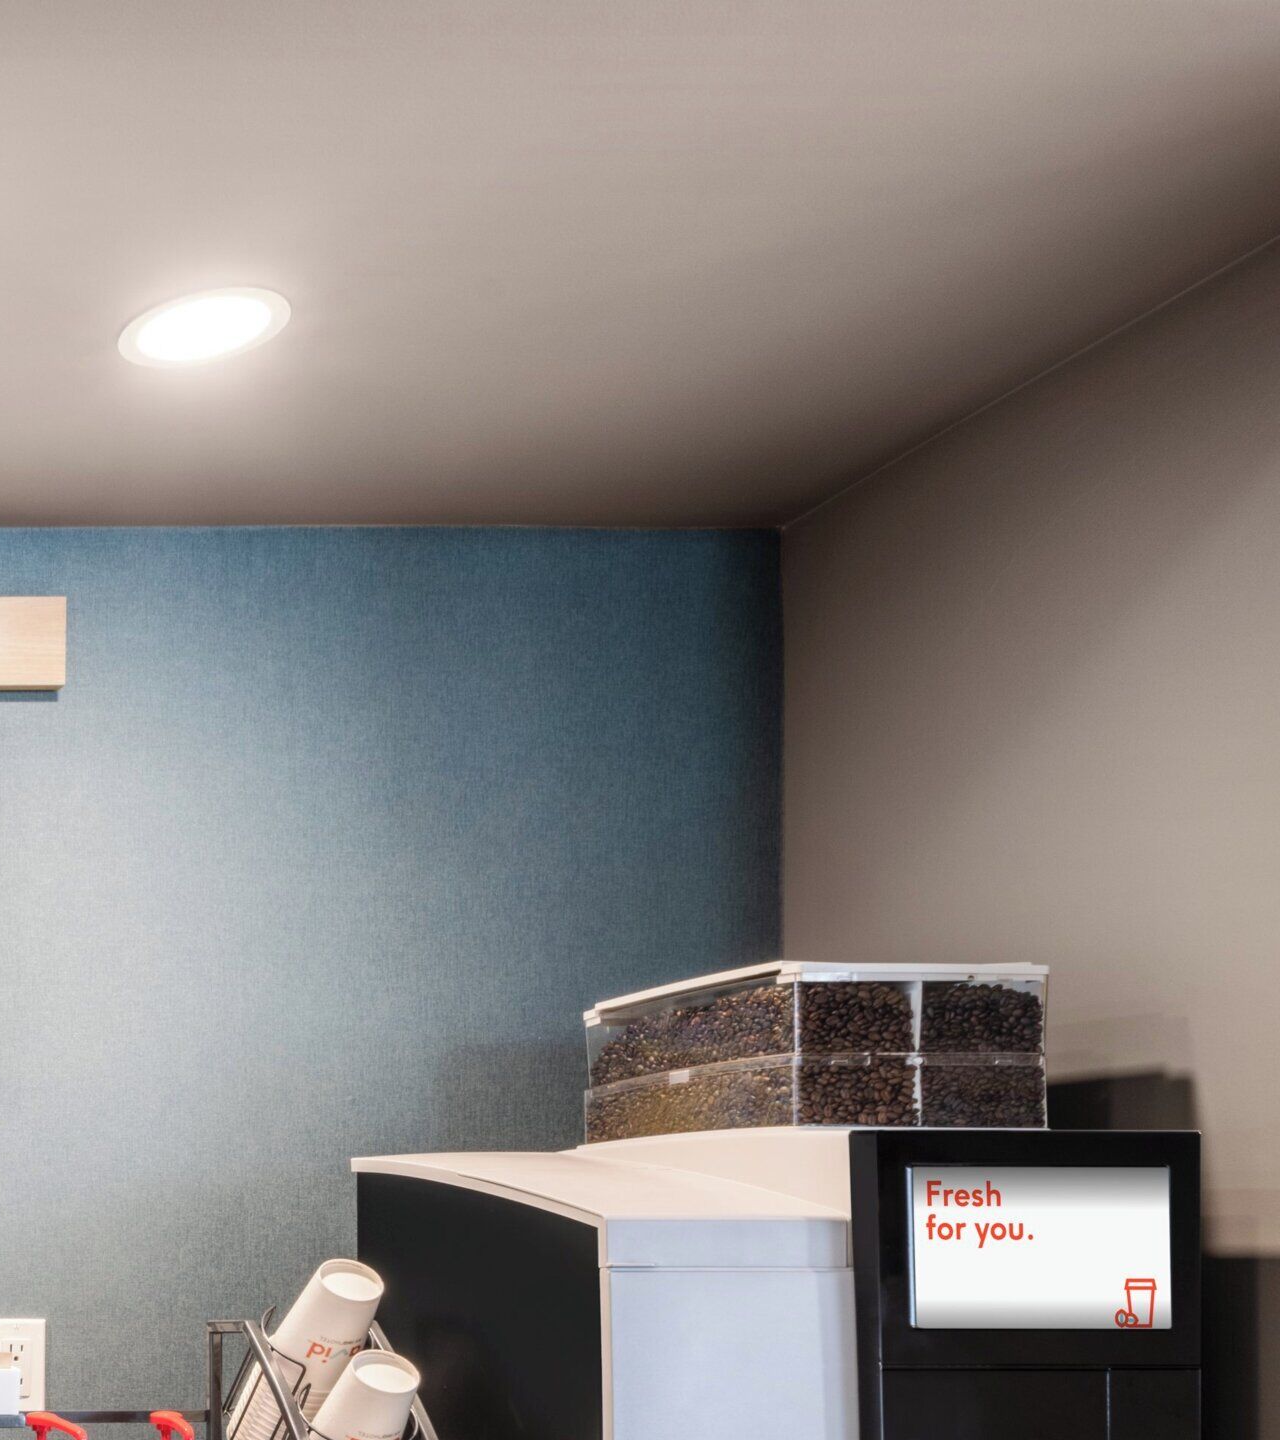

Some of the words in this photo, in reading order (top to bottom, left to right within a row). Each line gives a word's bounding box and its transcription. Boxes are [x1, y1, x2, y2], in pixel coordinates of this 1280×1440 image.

[925, 1180, 1002, 1208] Fresh
[925, 1213, 967, 1241] for
[974, 1221, 1034, 1249] you.
